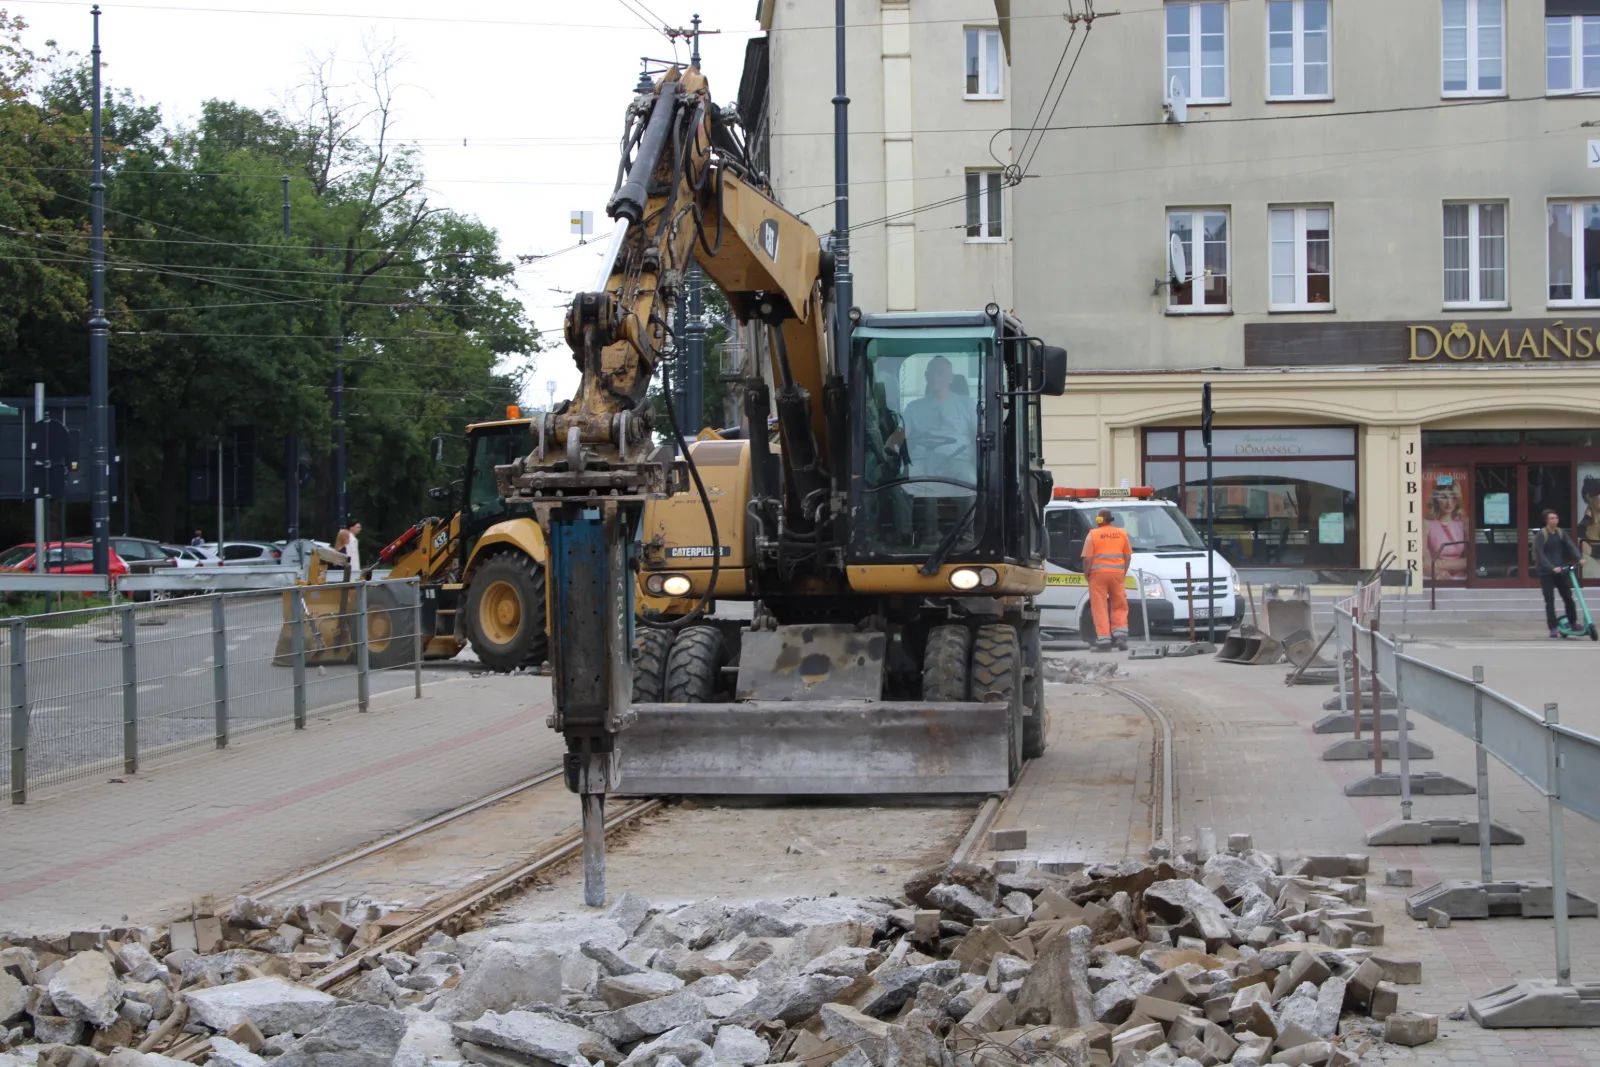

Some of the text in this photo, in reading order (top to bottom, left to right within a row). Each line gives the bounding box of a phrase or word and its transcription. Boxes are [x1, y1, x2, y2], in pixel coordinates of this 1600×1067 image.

[1407, 320, 1600, 360] DOMAŃS
[1405, 442, 1418, 572] JUBILER
[671, 547, 724, 557] CATERPILLR
[1047, 576, 1060, 584] MPK
